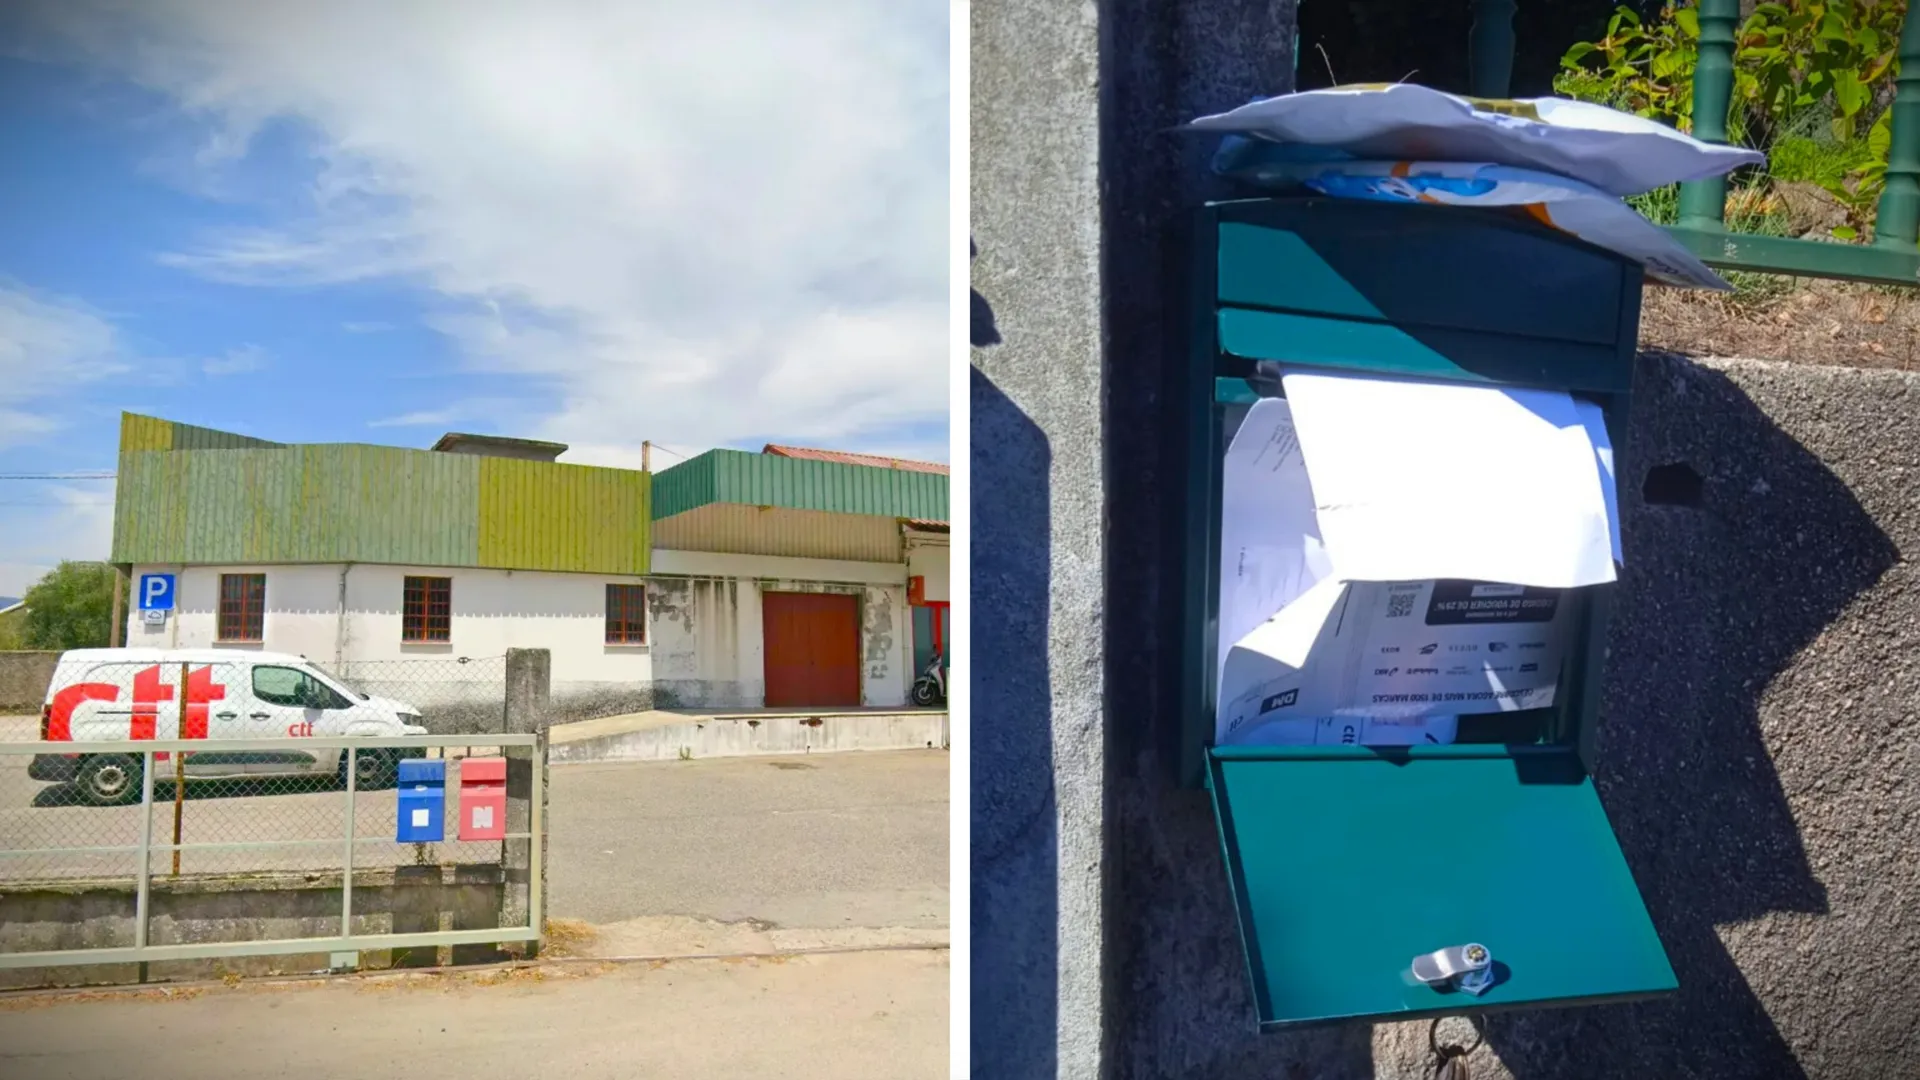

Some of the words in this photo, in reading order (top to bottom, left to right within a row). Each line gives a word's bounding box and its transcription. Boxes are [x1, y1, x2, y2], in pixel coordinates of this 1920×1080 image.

[146, 577, 167, 607] P
[1372, 693, 1410, 703] MARCAS
[1432, 692, 1443, 702] DE
[1444, 691, 1466, 701] MAIS
[48, 664, 225, 761] ctt
[288, 721, 314, 736] ctt
